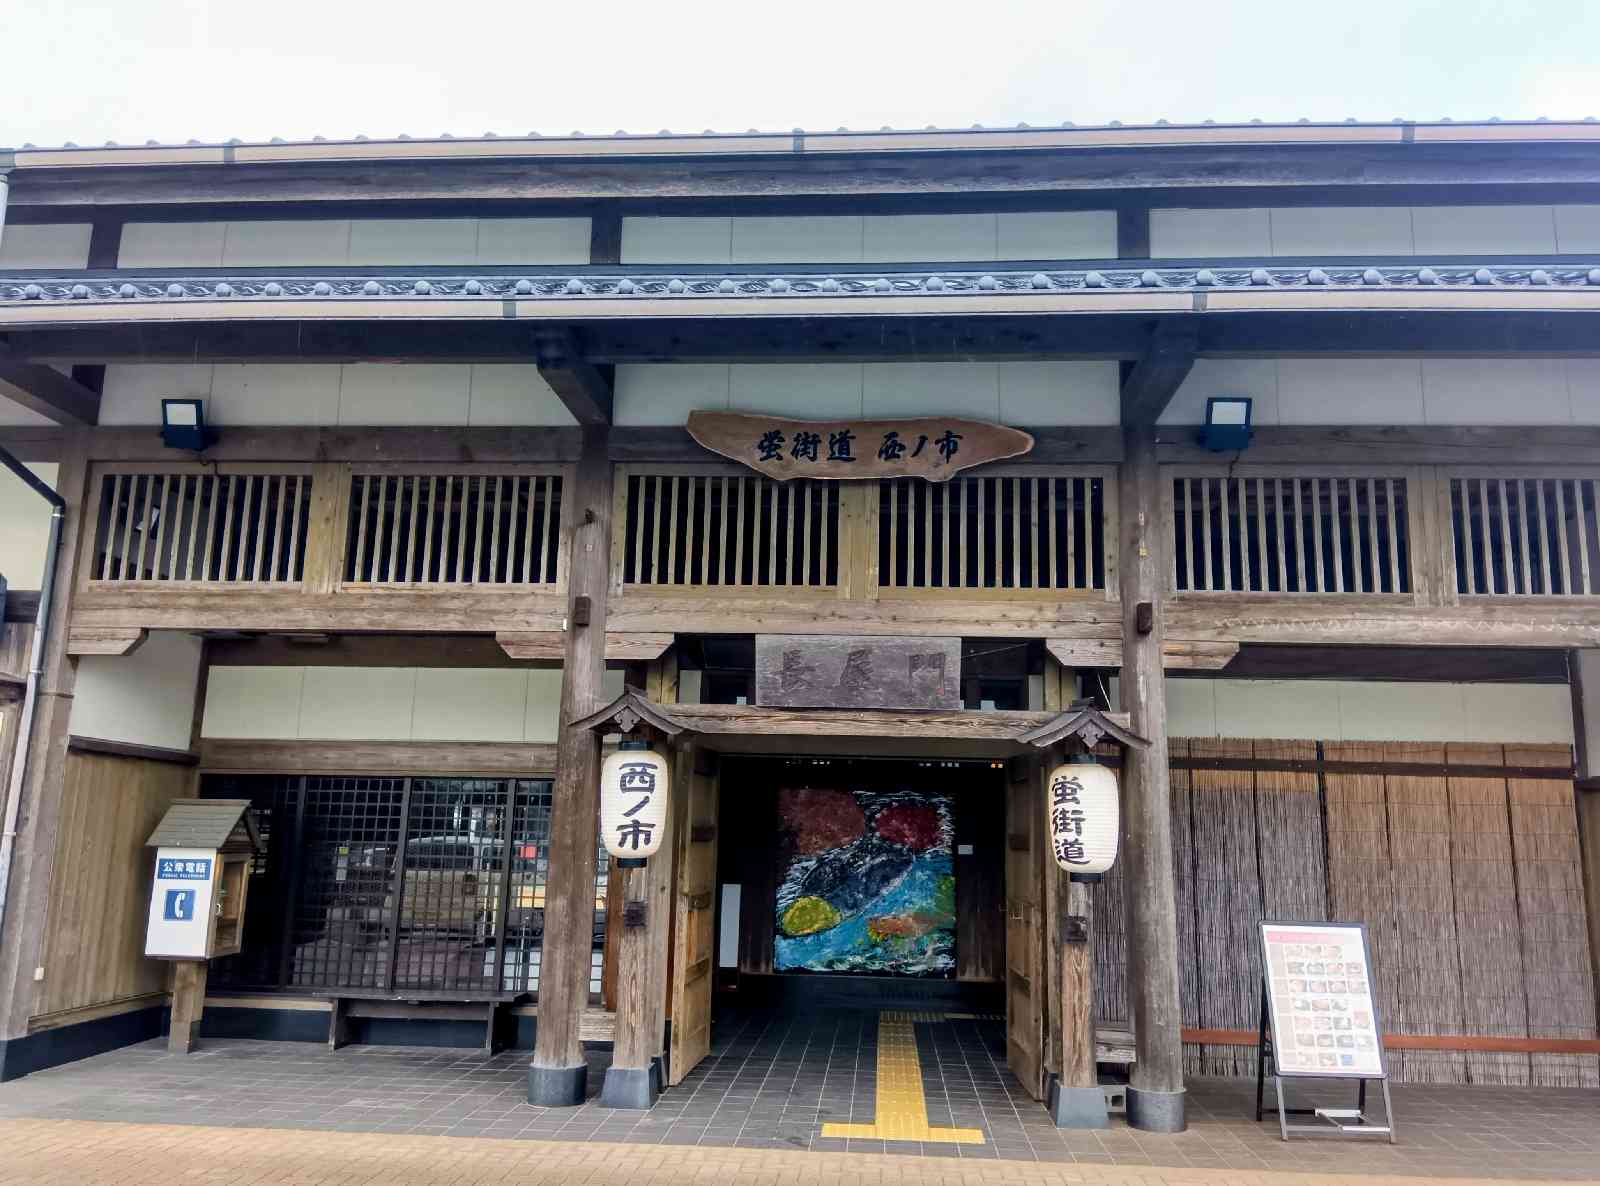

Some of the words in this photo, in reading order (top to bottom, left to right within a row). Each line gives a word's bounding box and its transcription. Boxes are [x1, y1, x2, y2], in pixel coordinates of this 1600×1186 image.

[757, 429, 857, 463] 蛍街道
[877, 430, 964, 464] 西ノ市
[616, 762, 658, 850] 西ノ市
[1052, 775, 1092, 865] 蛍街道
[162, 861, 208, 873] 公衆電話
